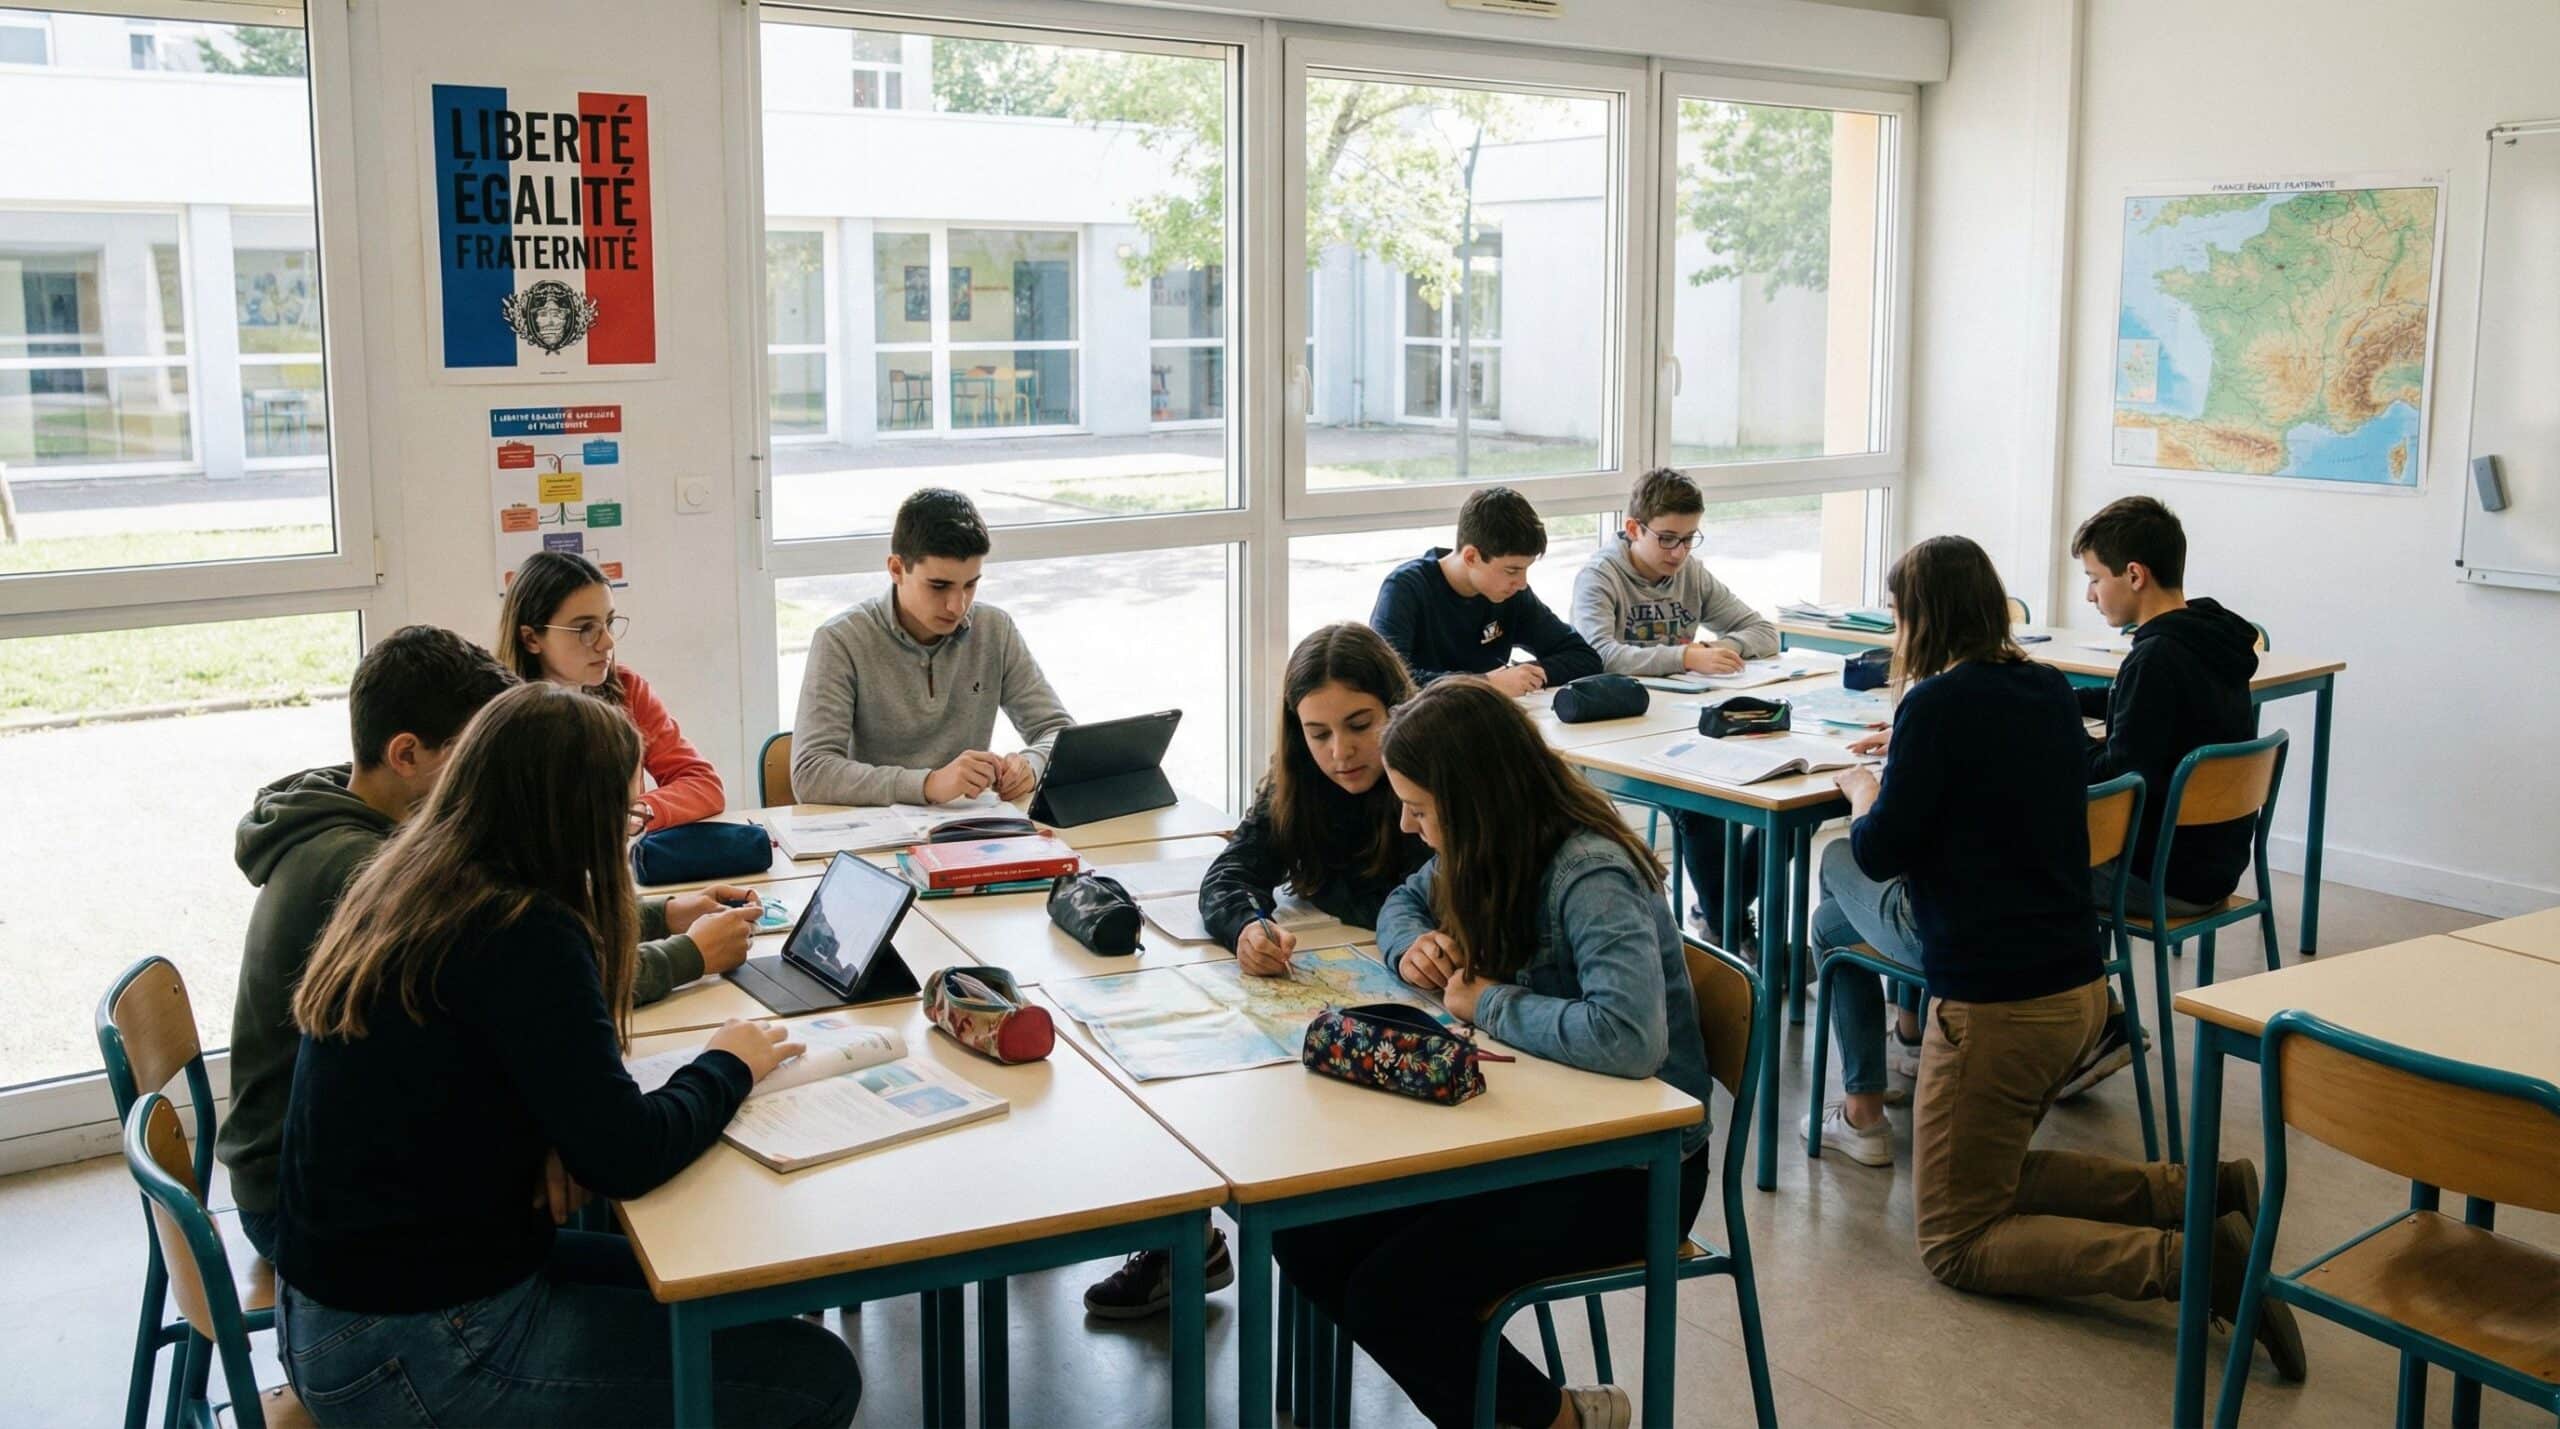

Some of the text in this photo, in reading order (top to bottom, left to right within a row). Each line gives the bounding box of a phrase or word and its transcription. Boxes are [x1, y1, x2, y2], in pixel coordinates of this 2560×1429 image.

[452, 103, 634, 164] LIBERTÉ
[454, 161, 637, 226] ÉGALITÉ
[456, 228, 638, 270] FRATERNITÉ
